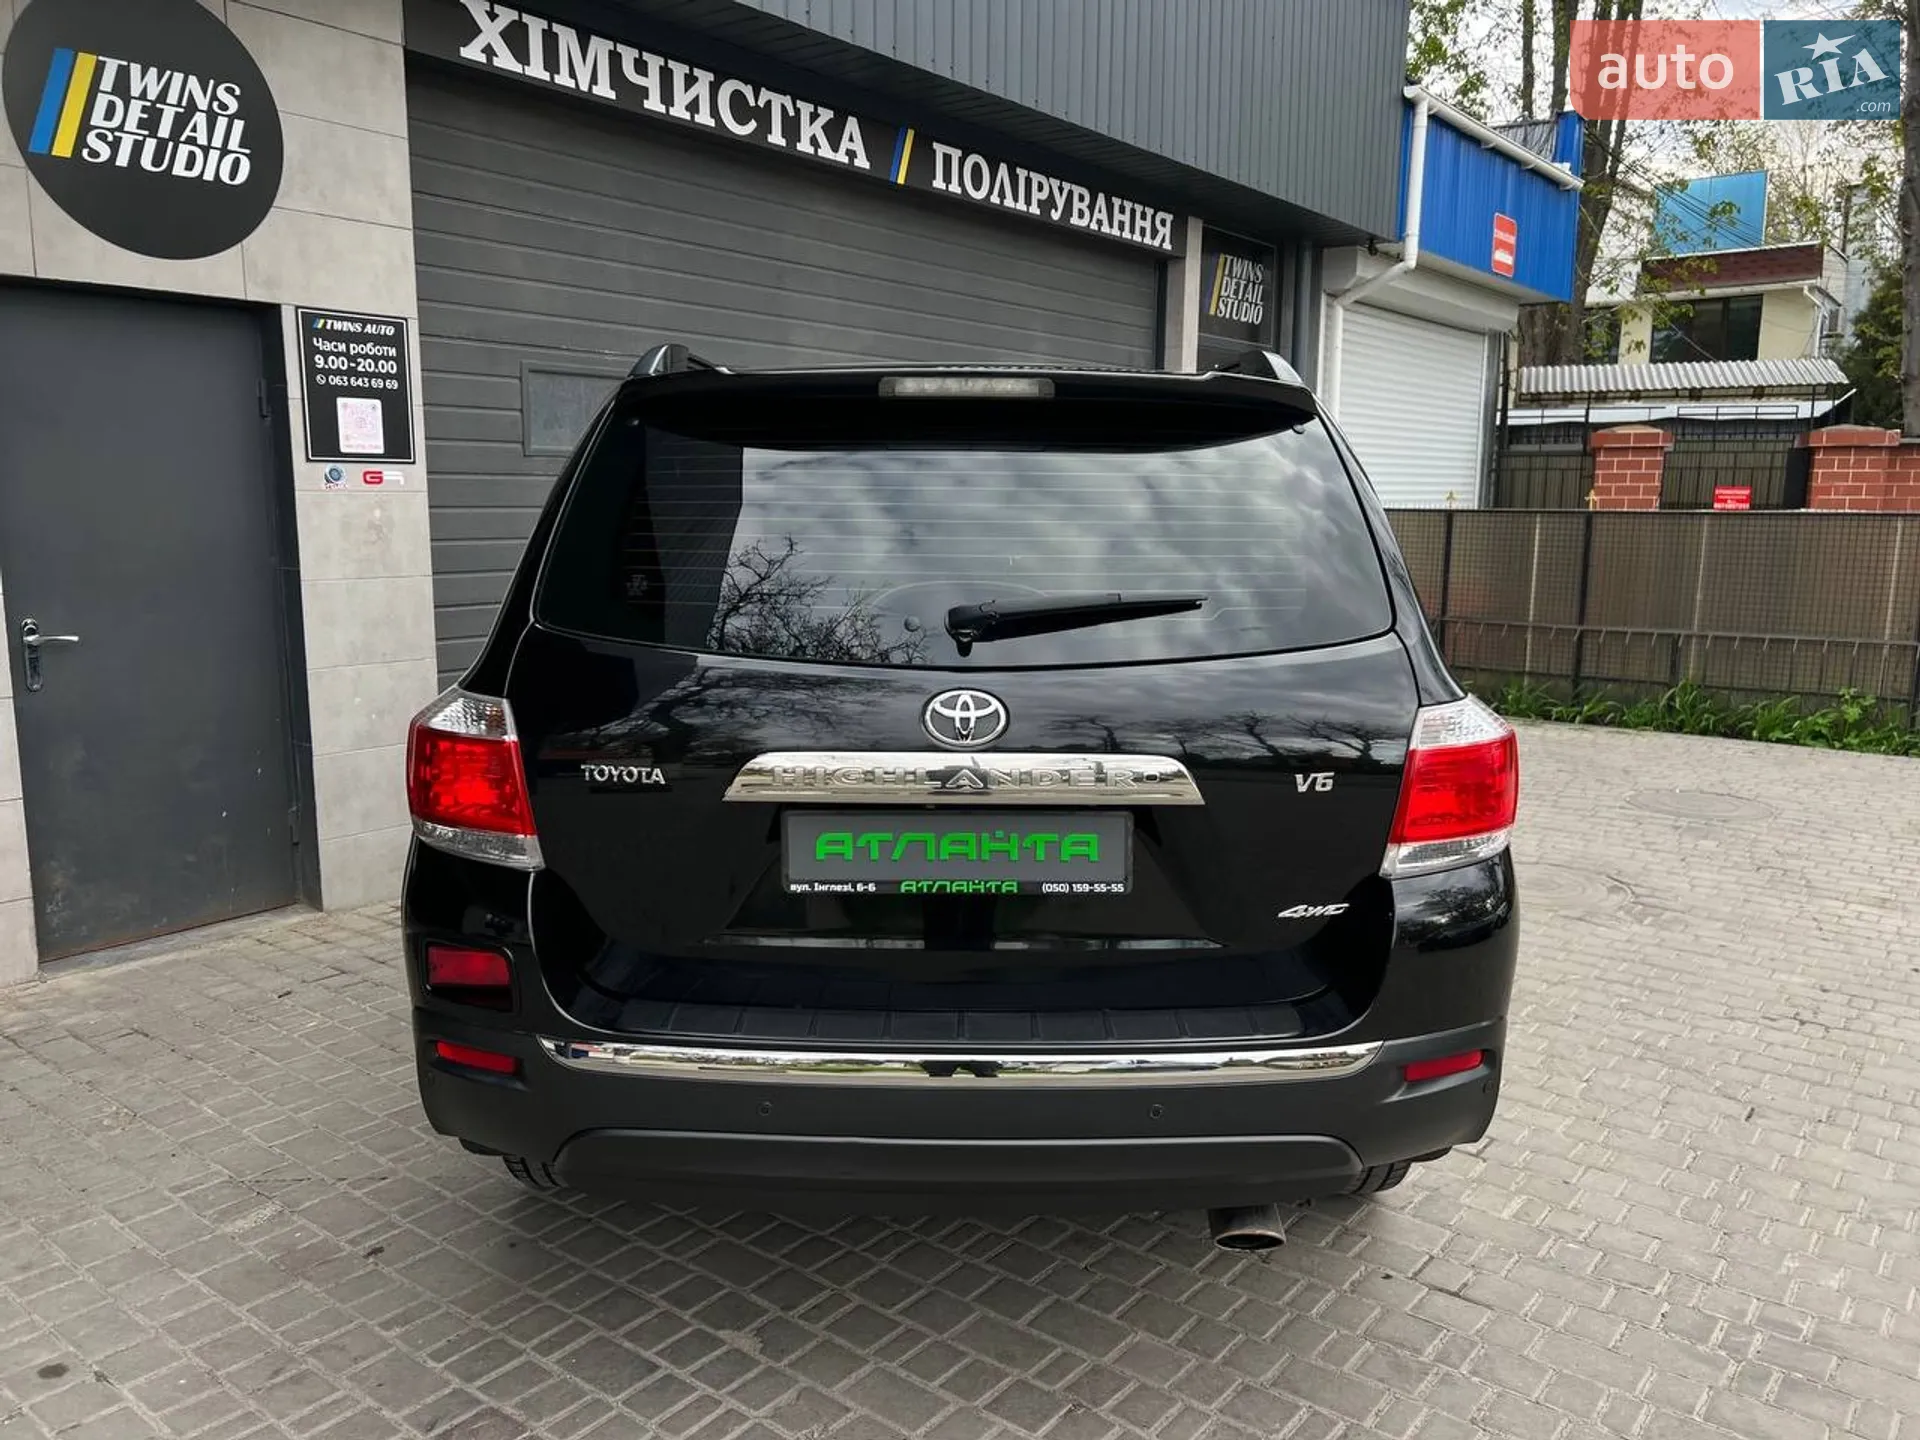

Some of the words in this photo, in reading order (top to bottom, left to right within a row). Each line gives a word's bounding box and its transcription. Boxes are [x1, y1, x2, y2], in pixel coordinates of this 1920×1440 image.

[97, 55, 241, 116] TWINS
[458, 0, 871, 169] ХІМЧИСТКА
[90, 93, 252, 154] DETAIL
[82, 131, 251, 186] STUDIO
[932, 141, 1174, 251] ПОЛІРУВАННЯ
[1224, 254, 1265, 284] TWINS
[1220, 276, 1264, 306] DETAIL
[1216, 297, 1263, 325] STUDIO
[326, 319, 362, 333] TWINS
[363, 323, 395, 336] AUTO
[312, 337, 347, 353] Часи
[349, 342, 397, 357] роботи
[328, 374, 349, 387] 063
[350, 376, 370, 388] 643
[370, 377, 384, 389] 69
[385, 379, 399, 390] 69
[580, 764, 666, 786] TOYOTA
[771, 766, 1138, 792] HIGHLANDER
[1293, 770, 1335, 794] V6
[1042, 882, 1070, 894] (050)
[1073, 882, 1124, 893] 159-55-55
